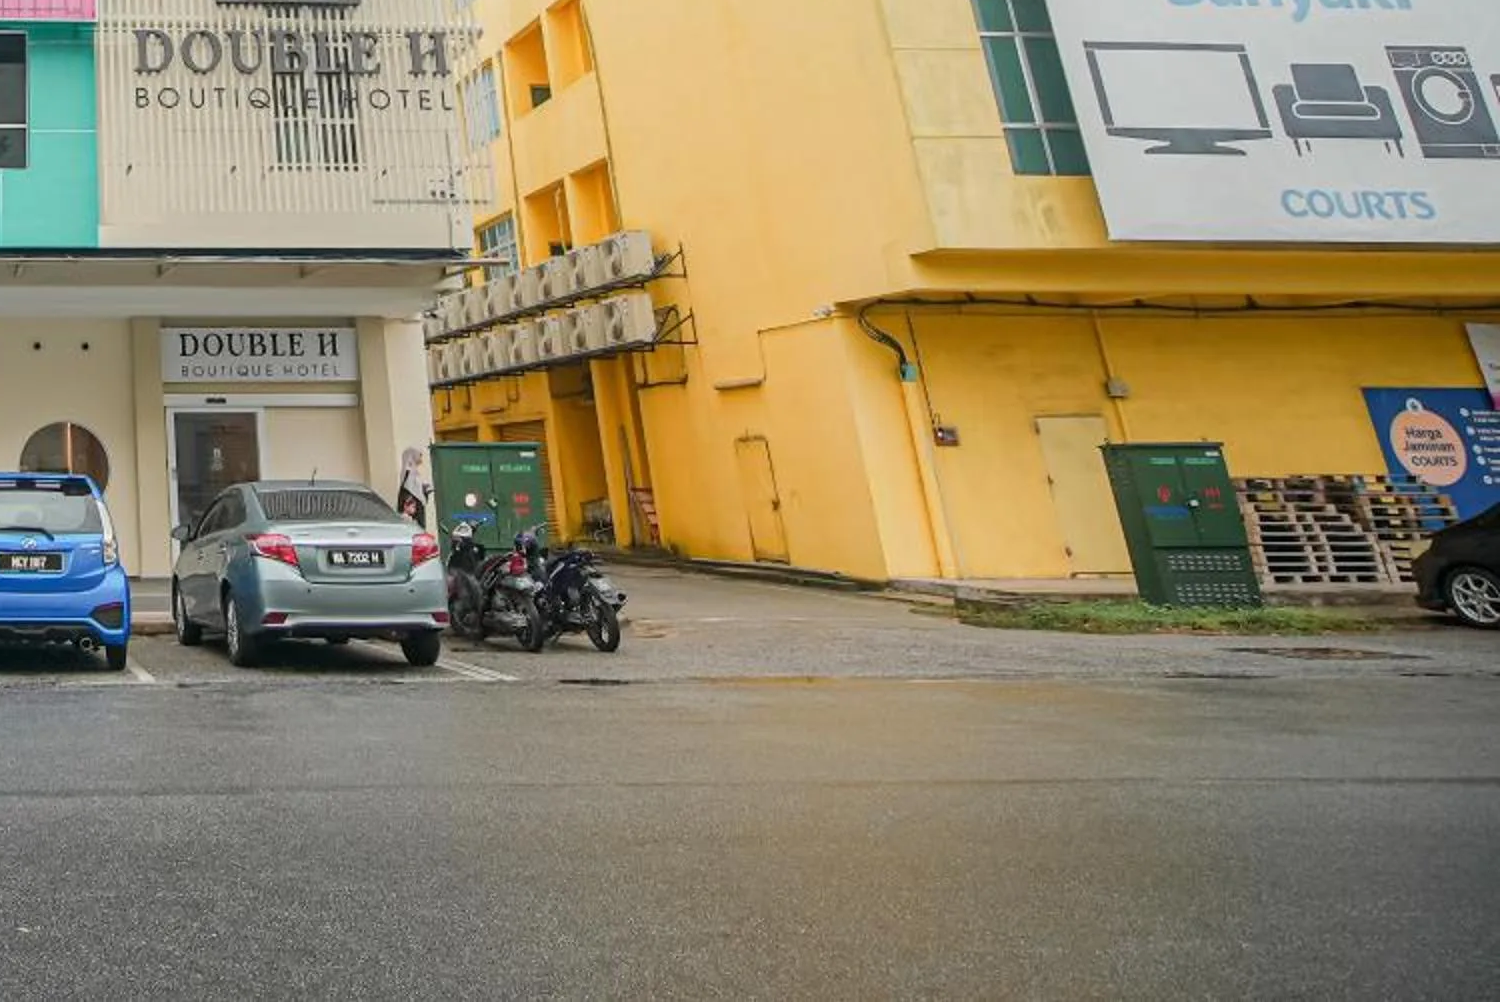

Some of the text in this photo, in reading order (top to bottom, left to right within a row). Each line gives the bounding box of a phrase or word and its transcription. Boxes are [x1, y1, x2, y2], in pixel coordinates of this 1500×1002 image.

[132, 29, 452, 78] DOUBLE H
[134, 87, 454, 111] BOUTIQUE HOTEL
[1280, 189, 1437, 220] COURTS
[179, 333, 340, 357] DOUBLE H
[181, 364, 341, 378] BOUTIQUE HOTEL
[1405, 427, 1443, 440] Harga
[1411, 455, 1458, 467] COURTS
